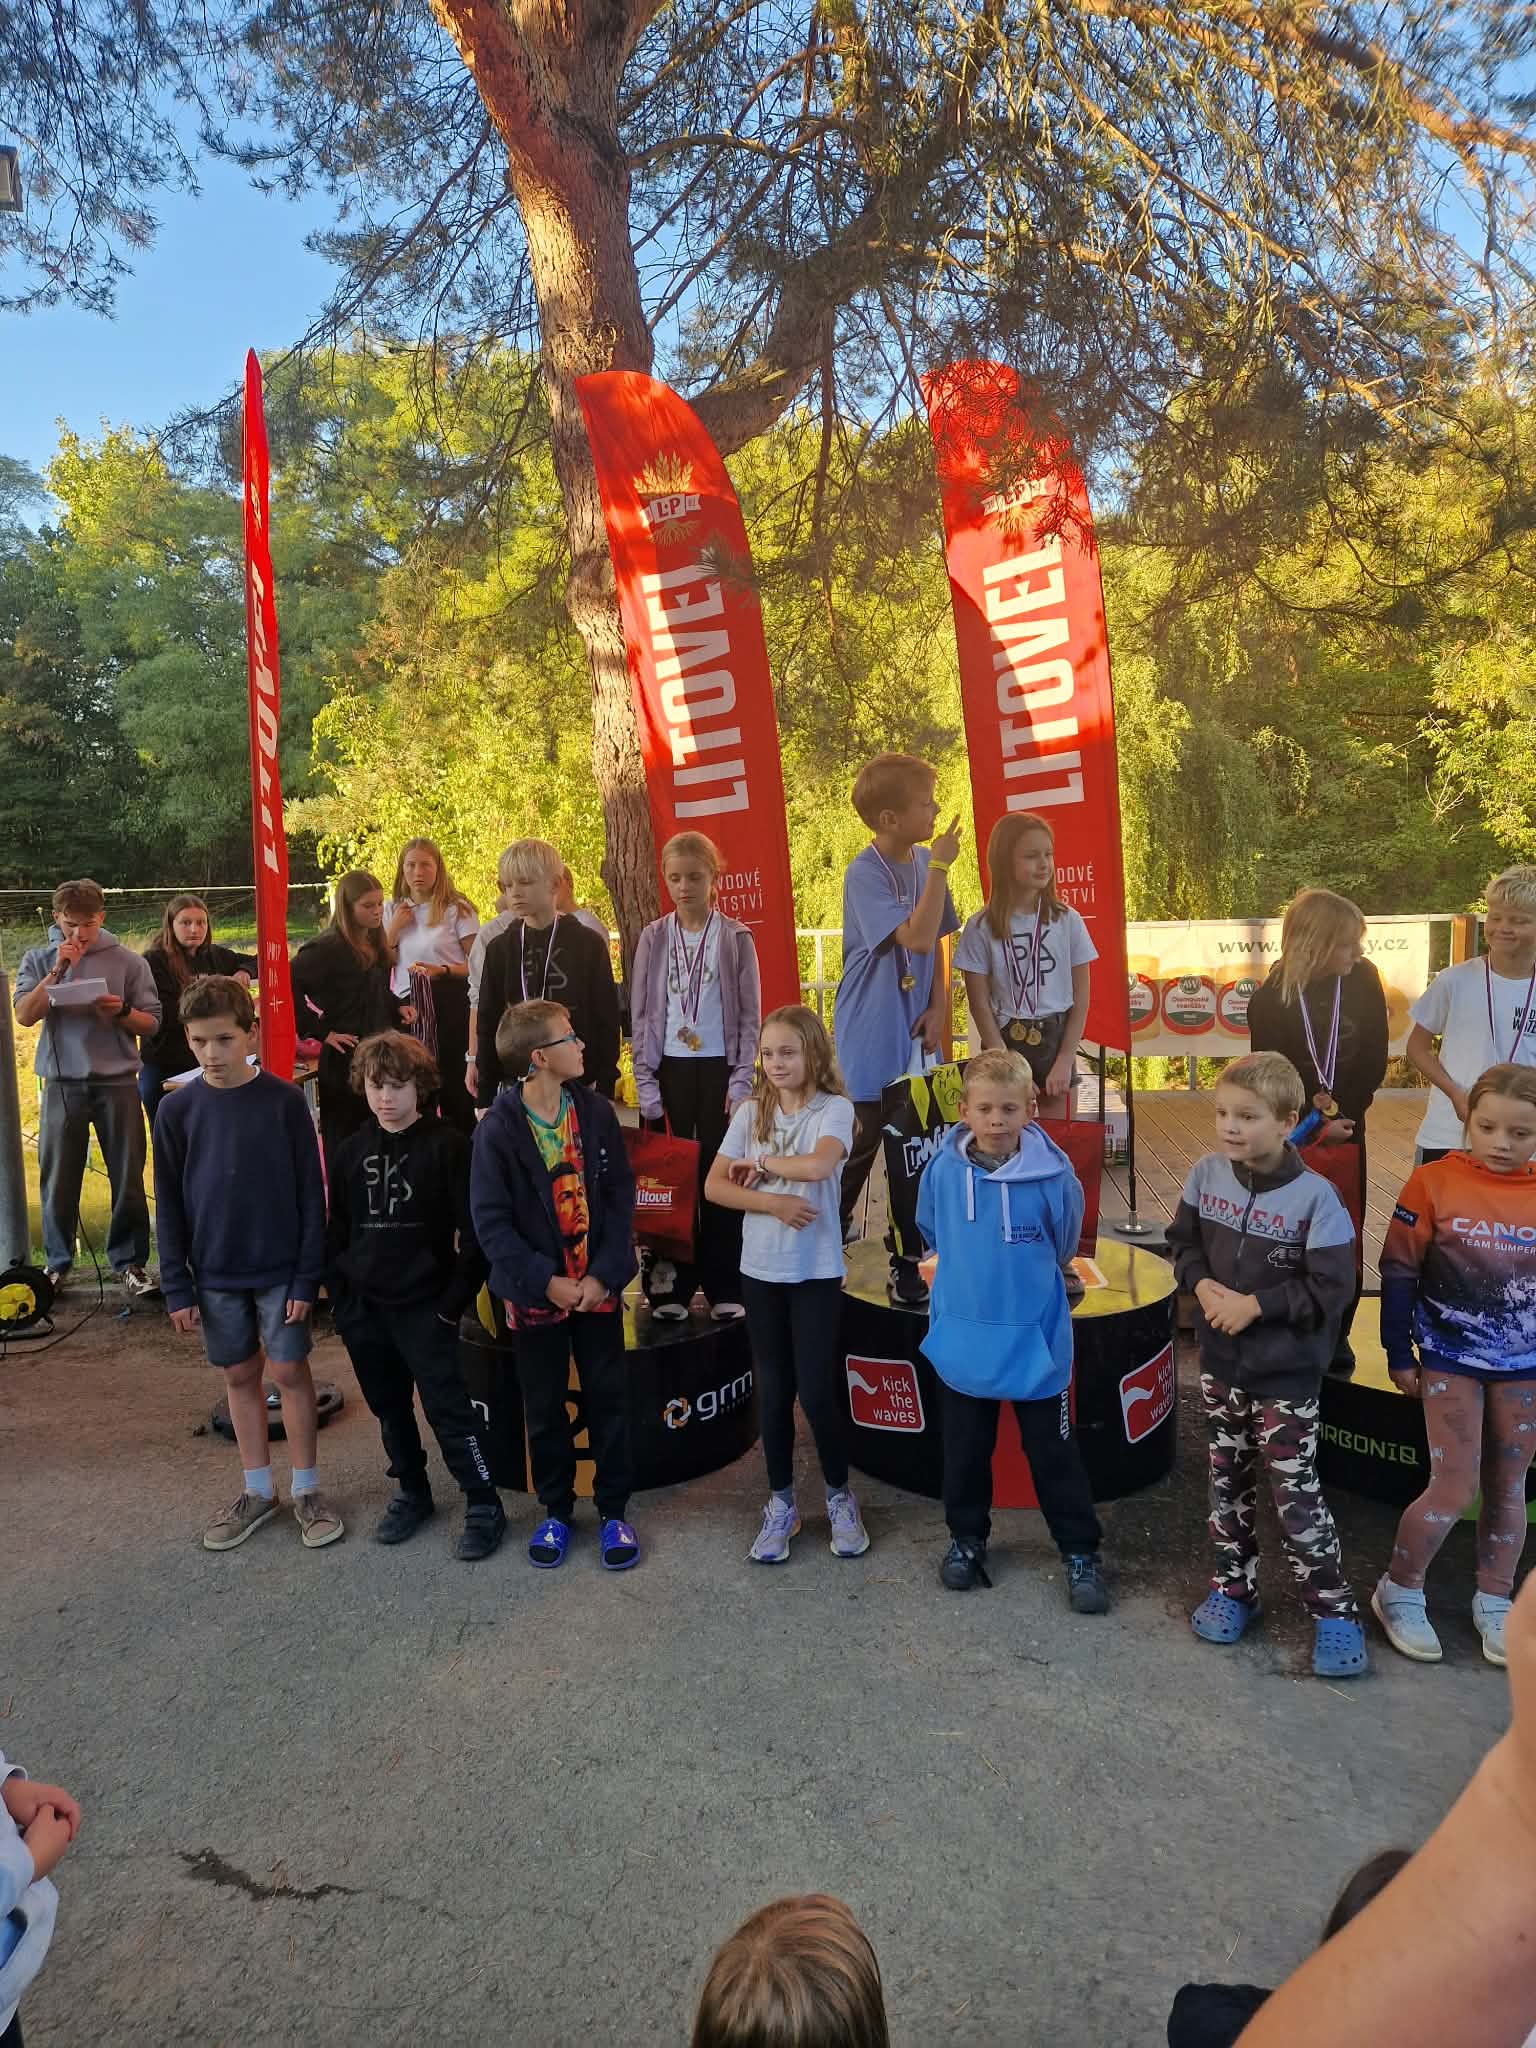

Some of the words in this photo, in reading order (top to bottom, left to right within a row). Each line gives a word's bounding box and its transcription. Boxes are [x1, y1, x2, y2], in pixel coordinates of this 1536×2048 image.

[983, 533, 1085, 813] LITOVEL
[1055, 883, 1095, 906] STVÍ
[636, 1189, 672, 1206] Litovel
[1460, 1237, 1491, 1249] TEAM
[881, 1375, 912, 1393] kick
[889, 1393, 913, 1409] the
[872, 1408, 917, 1424] waves
